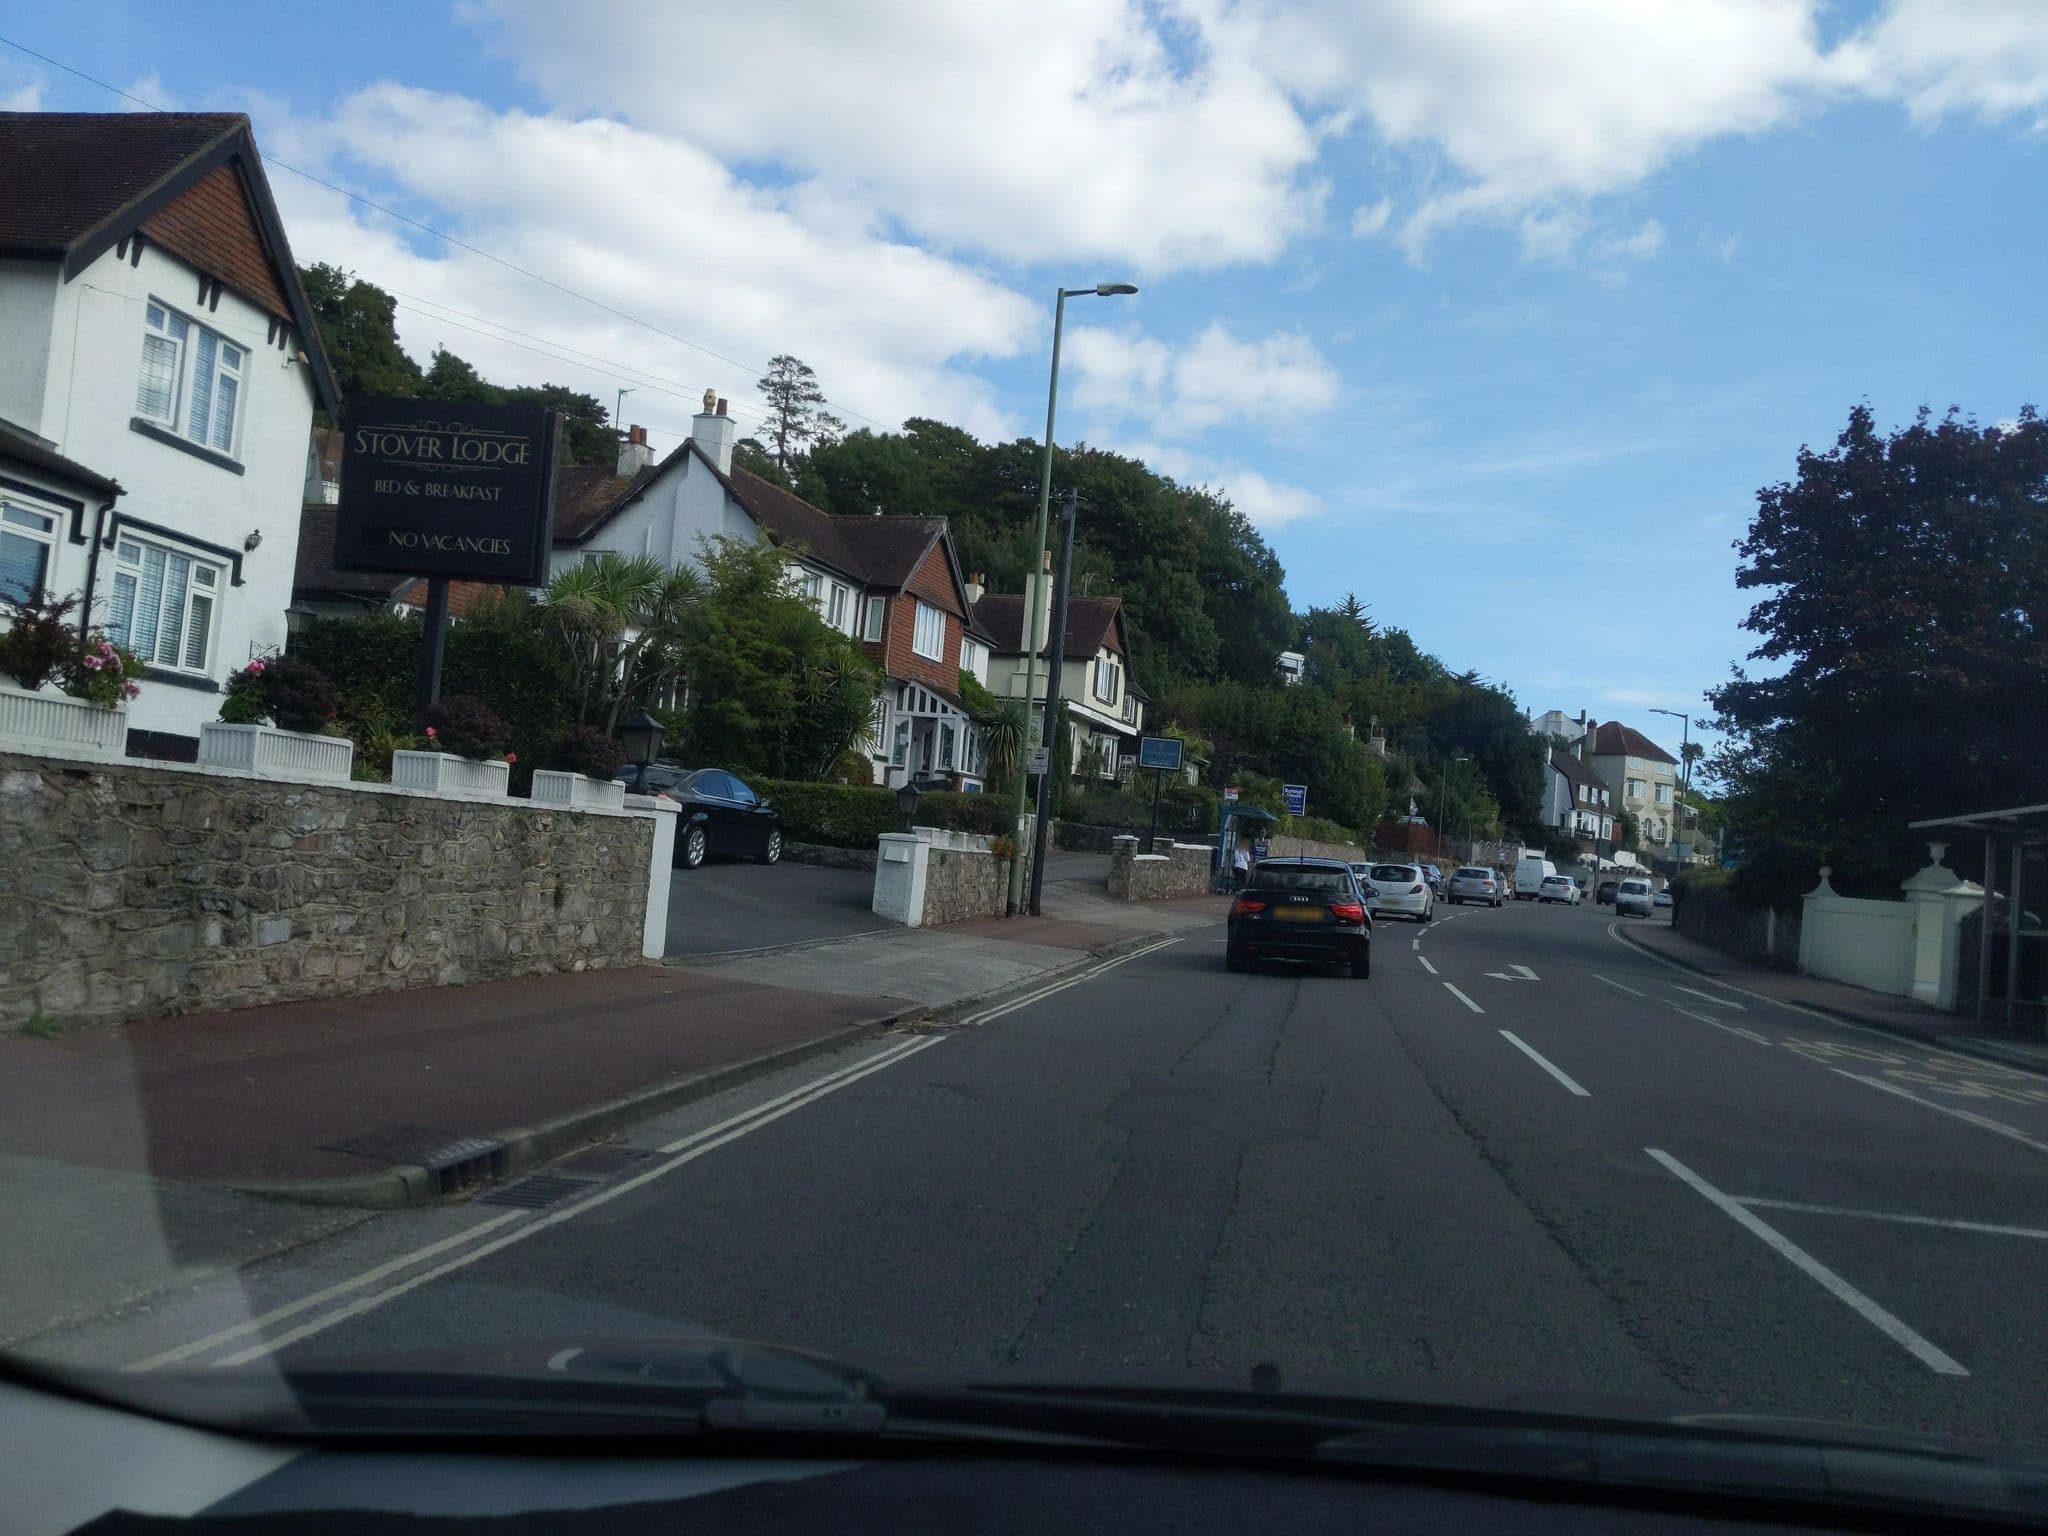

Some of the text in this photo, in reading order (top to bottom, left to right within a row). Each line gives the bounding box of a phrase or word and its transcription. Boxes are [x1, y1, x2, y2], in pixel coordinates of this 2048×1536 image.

[354, 430, 531, 465] STOVER LODGE
[375, 480, 503, 501] BED & BREAKFAST
[389, 531, 511, 555] NO VACANCIES
